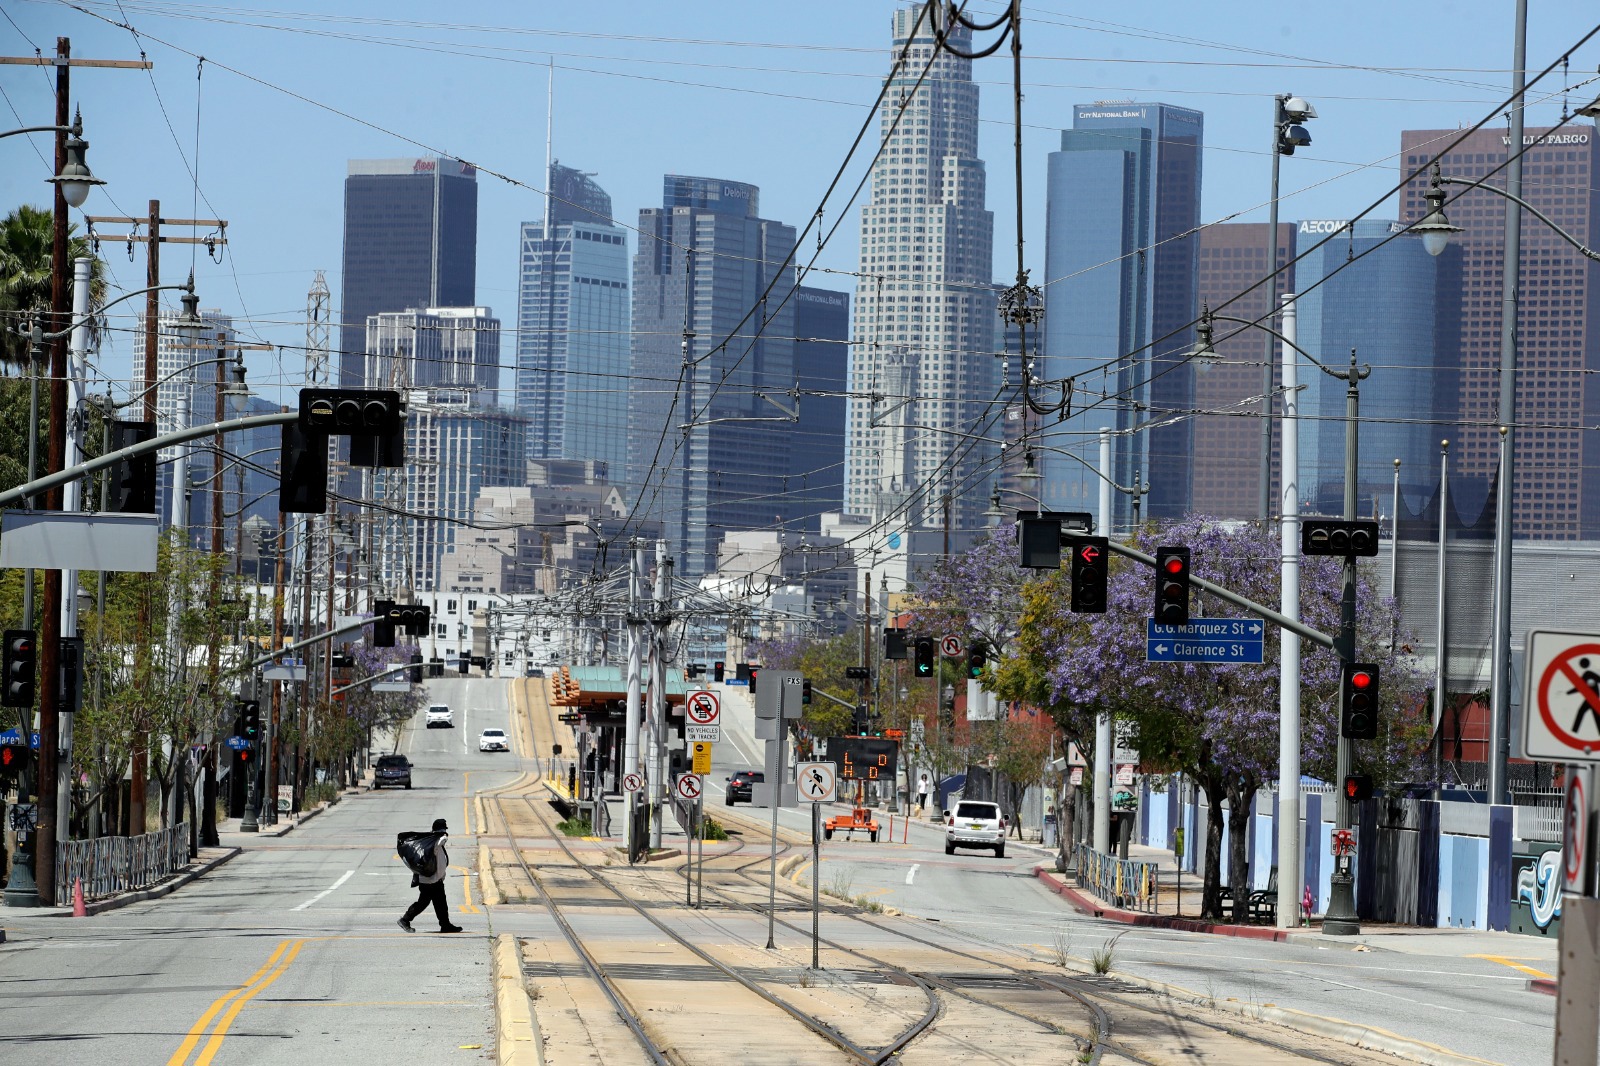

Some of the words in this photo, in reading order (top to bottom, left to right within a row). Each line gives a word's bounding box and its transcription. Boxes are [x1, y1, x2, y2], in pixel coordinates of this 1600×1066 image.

[1092, 111, 1122, 119] NATIONAL
[1123, 110, 1140, 118] BANK
[1502, 135, 1545, 145] WLLS
[1548, 134, 1588, 145] FARGO
[1300, 220, 1346, 233] AECOM
[1177, 623, 1228, 636] Marquez
[1231, 623, 1245, 635] St
[1173, 643, 1226, 656] Clarence
[1230, 644, 1245, 657] St
[844, 752, 853, 765] L
[844, 765, 853, 778] H
